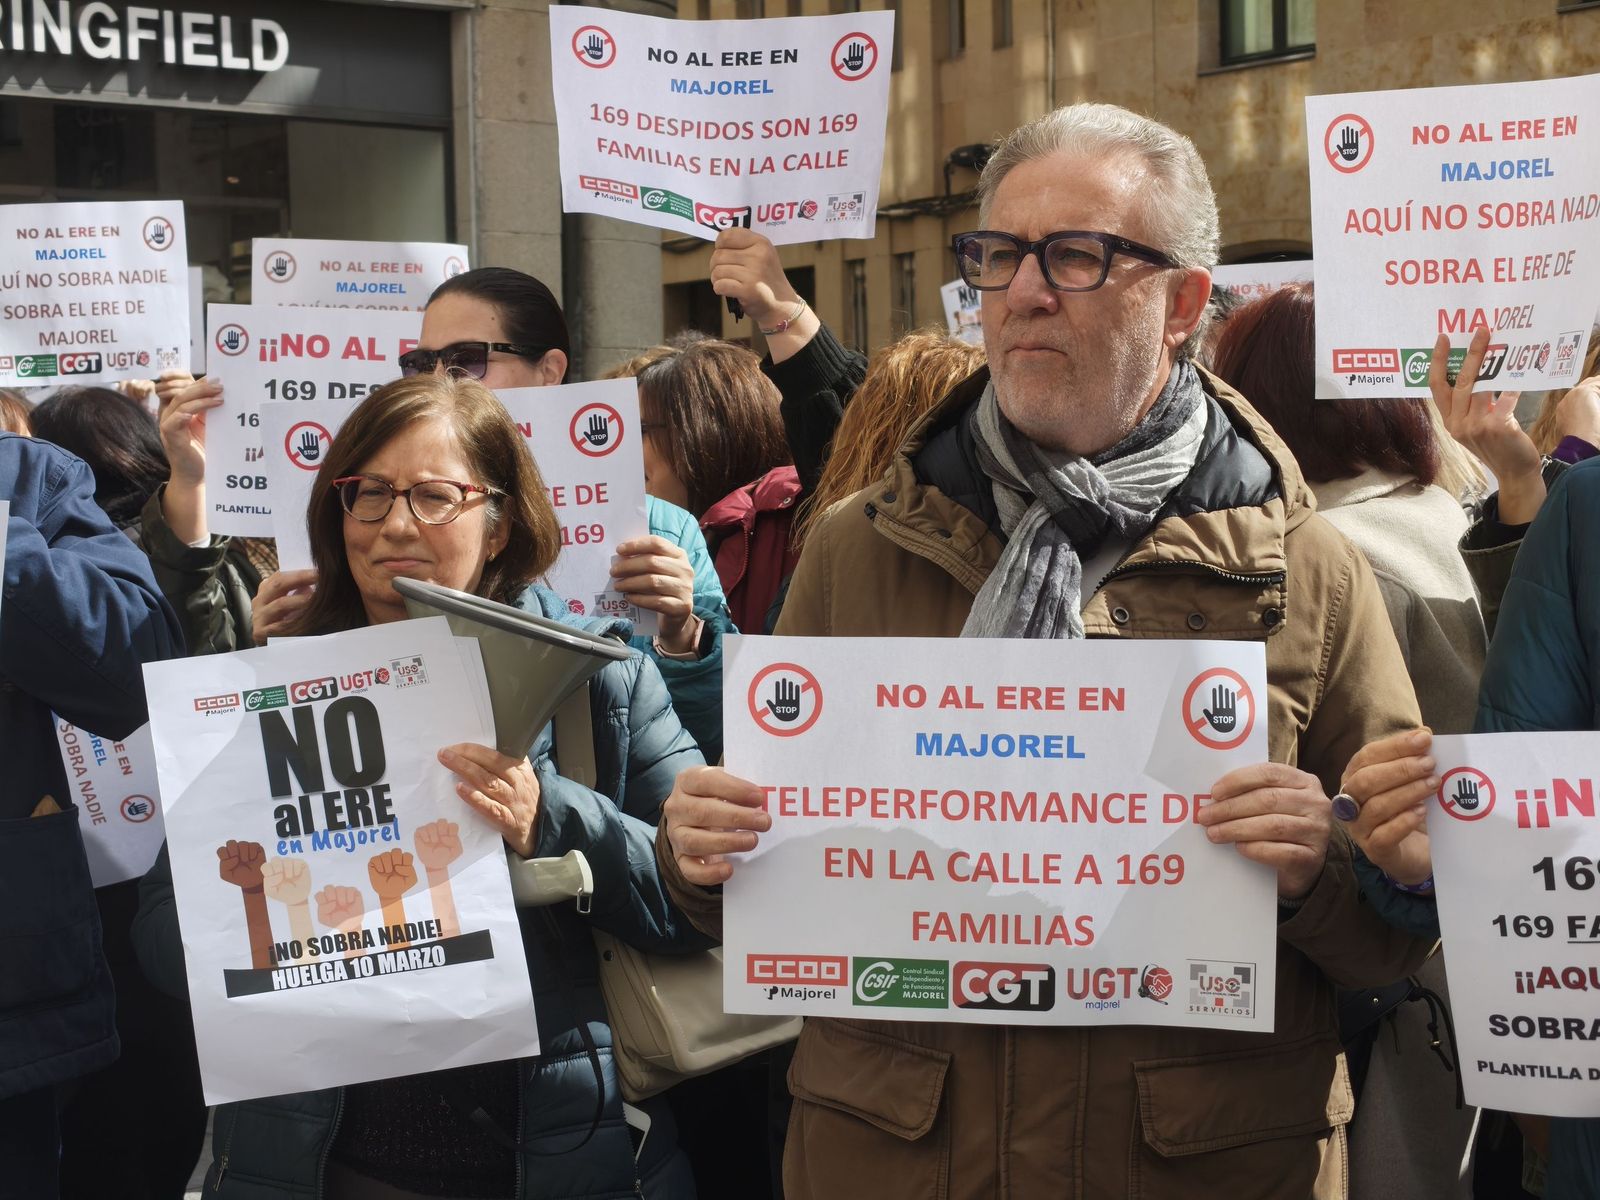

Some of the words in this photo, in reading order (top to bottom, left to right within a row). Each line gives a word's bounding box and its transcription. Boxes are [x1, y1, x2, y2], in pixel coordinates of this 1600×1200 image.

[0, 0, 288, 72] INGFIELD
[648, 46, 678, 64] NO
[684, 50, 713, 67] AL
[721, 49, 762, 67] ERE
[770, 48, 798, 65] EN
[670, 78, 774, 96] MAJOREL
[589, 102, 629, 126] 169
[637, 112, 754, 141] DESPIDOS
[760, 117, 810, 139] SON
[818, 112, 858, 135] 169
[1412, 125, 1450, 145] NO
[1459, 123, 1493, 143] AL
[1501, 119, 1546, 141] ERE
[1552, 115, 1578, 137] EN
[597, 137, 701, 175] FAMILIAS
[709, 158, 741, 177] EN
[750, 156, 776, 176] LA
[783, 149, 849, 171] CALLE
[1441, 157, 1555, 182] MAJOREL
[583, 177, 634, 197] CCOO
[600, 192, 633, 205] Majorel
[833, 200, 857, 211] USO
[699, 207, 749, 231] CGT
[757, 202, 798, 222] UGT
[1344, 200, 1414, 236] AQUÍ
[1422, 203, 1468, 230] NO
[1477, 200, 1556, 229] SOBRA
[16, 228, 39, 240] NO
[44, 227, 64, 239] AL
[69, 226, 96, 238] ERE
[101, 225, 120, 237] EN
[35, 248, 107, 261] MAJOREL
[319, 260, 342, 272] NO
[346, 261, 365, 273] AL
[371, 261, 399, 273] ERE
[404, 263, 423, 274] EN
[1385, 257, 1484, 286] SOBRA
[1493, 257, 1517, 283] EL
[1522, 254, 1553, 281] ERE
[1554, 250, 1576, 277] DE
[0, 270, 20, 292] UÍ
[26, 273, 53, 288] NO
[58, 271, 114, 287] SOBRA
[118, 269, 168, 285] NADIE
[335, 281, 407, 294] MAJOREL
[3, 303, 64, 320] SOBRA
[69, 302, 87, 317] EL
[91, 301, 120, 316] ERE
[125, 300, 146, 314] DE
[1438, 304, 1535, 334] MAJOREL
[38, 329, 118, 347] MAJOREL
[106, 351, 136, 367] UGT
[341, 336, 386, 362] AL
[1506, 344, 1540, 371] UGT
[62, 354, 100, 373] CGT
[1337, 353, 1394, 368] CCOO
[264, 379, 316, 401] 169
[1357, 374, 1394, 385] Majorel
[590, 433, 607, 441] STOP
[543, 485, 567, 508] E
[575, 482, 609, 506] DE
[560, 523, 605, 546] 169
[601, 600, 629, 611] USO
[397, 664, 419, 676] USO
[293, 680, 334, 701] CGT
[340, 671, 374, 691] UGT
[197, 695, 236, 709] CCOO
[876, 683, 927, 709] NO
[938, 685, 984, 711] AL
[997, 685, 1065, 711] ERE
[1078, 686, 1126, 712] EN
[210, 707, 236, 715] Majorel
[775, 705, 798, 714] STOP
[1212, 715, 1235, 724] STOP
[113, 740, 125, 754] E
[258, 695, 387, 798] NO
[915, 732, 1086, 760] MAJOREL
[60, 723, 88, 778] SOBRA
[79, 780, 107, 826] NADIE
[117, 755, 133, 776] EN
[273, 795, 316, 838] al
[322, 783, 396, 832] ERE
[760, 786, 1147, 824] TELEPERFORMANCE
[1162, 794, 1212, 825] DE
[1515, 778, 1600, 828] ¡¡N
[277, 838, 303, 856] en
[311, 817, 401, 853] Majorel
[824, 846, 873, 879] EN
[889, 849, 935, 882] LA
[947, 851, 1062, 885] CALLE
[1074, 853, 1103, 886] A
[1116, 853, 1186, 886] 169
[912, 911, 1095, 947] FAMILIAS
[1492, 914, 1554, 939] 169
[307, 928, 375, 958] SOBRA
[378, 918, 443, 947] NADIE!
[271, 959, 349, 990] HUELGA
[350, 955, 374, 979] 10
[378, 945, 446, 975] MARZO
[754, 960, 841, 980] CCOO
[781, 987, 836, 1001] Majorel
[960, 968, 1049, 1005] CGT
[1066, 967, 1139, 1000] UGT
[1199, 975, 1241, 993] USO
[902, 991, 945, 999] MAJOREL
[1085, 1000, 1120, 1011] majorel
[1188, 1005, 1250, 1016] SERVICIOS
[1477, 1060, 1583, 1081] PLANTILLA
